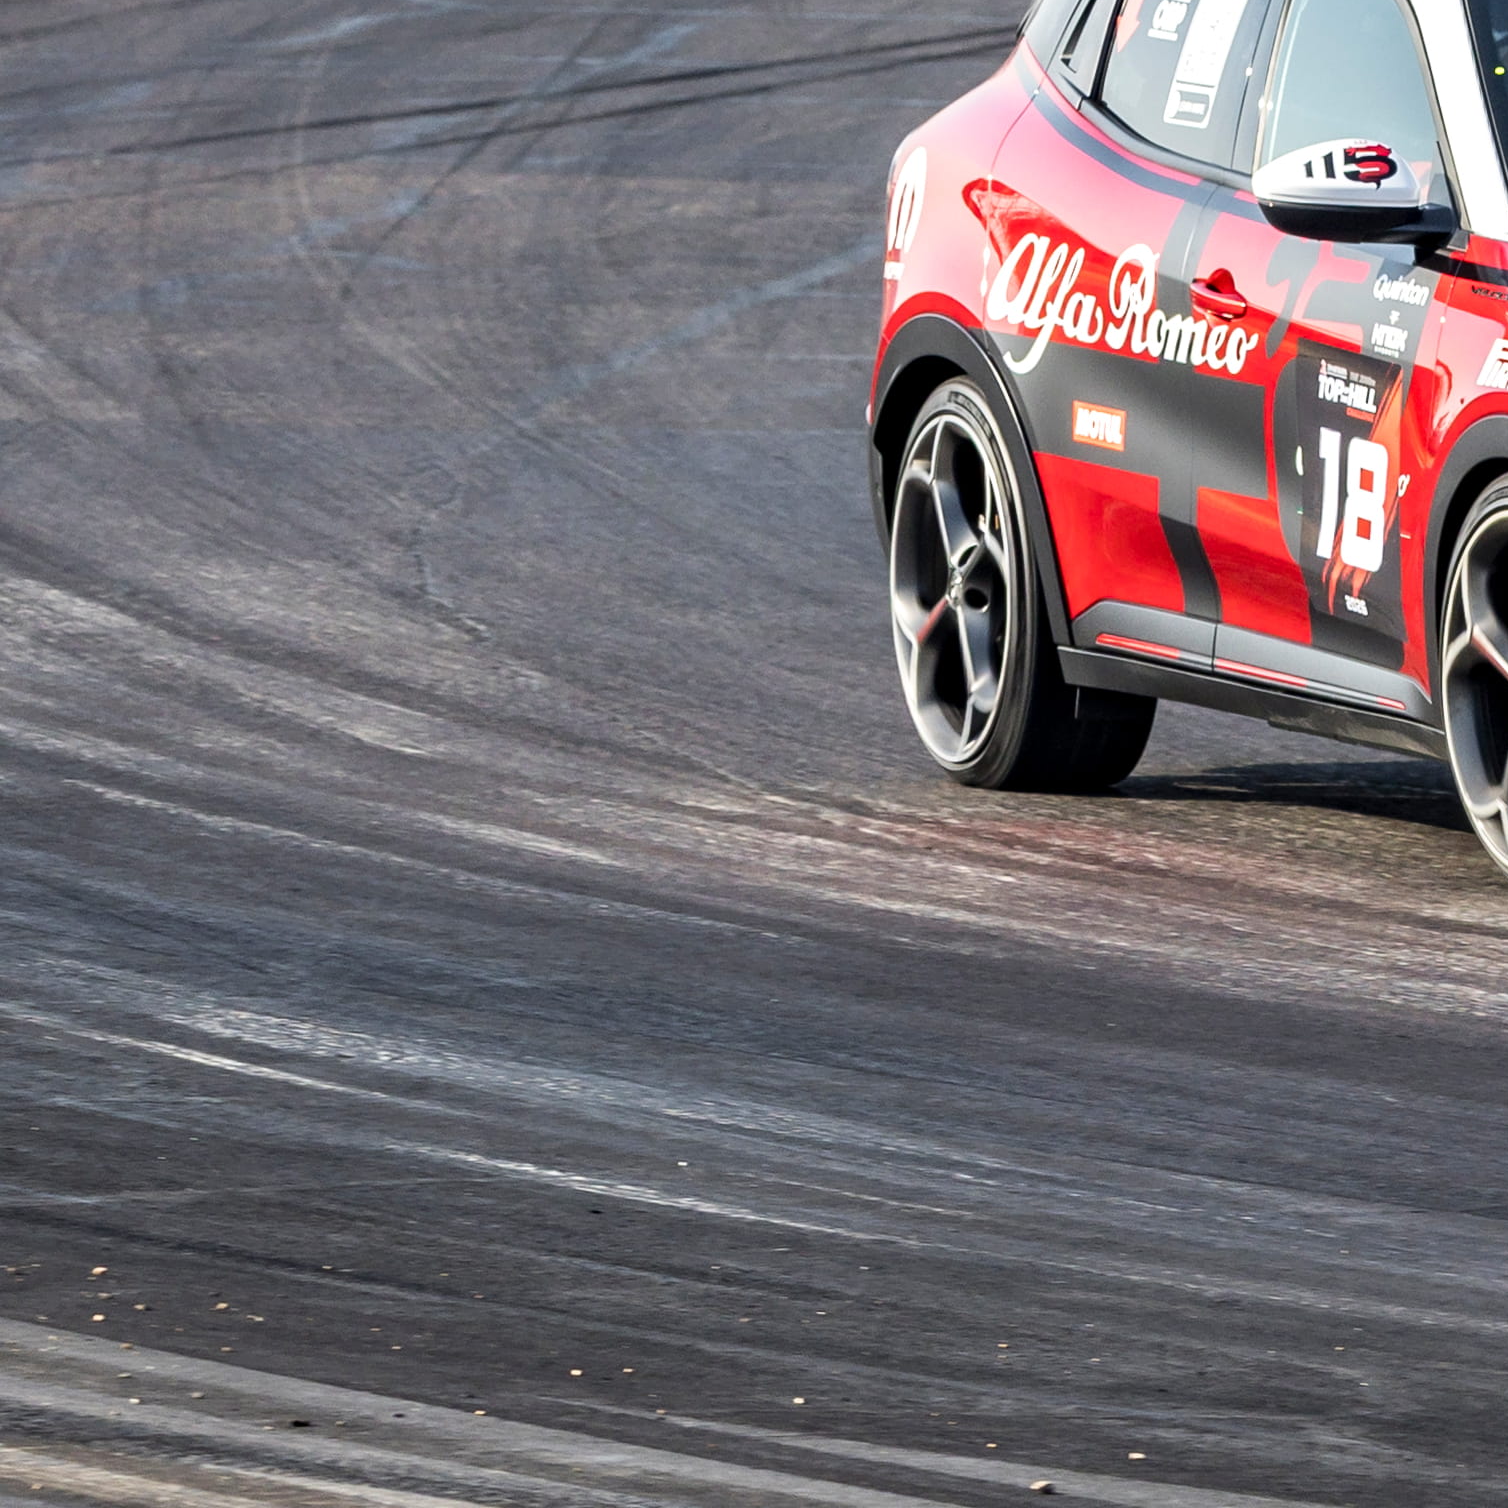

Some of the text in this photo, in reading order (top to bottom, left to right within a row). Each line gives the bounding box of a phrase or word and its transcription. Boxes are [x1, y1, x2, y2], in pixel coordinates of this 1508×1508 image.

[987, 232, 1258, 374] Alfa Romeo
[1373, 274, 1430, 306] Quinton
[1076, 408, 1123, 445] MOTUL
[1316, 426, 1389, 573] 18
